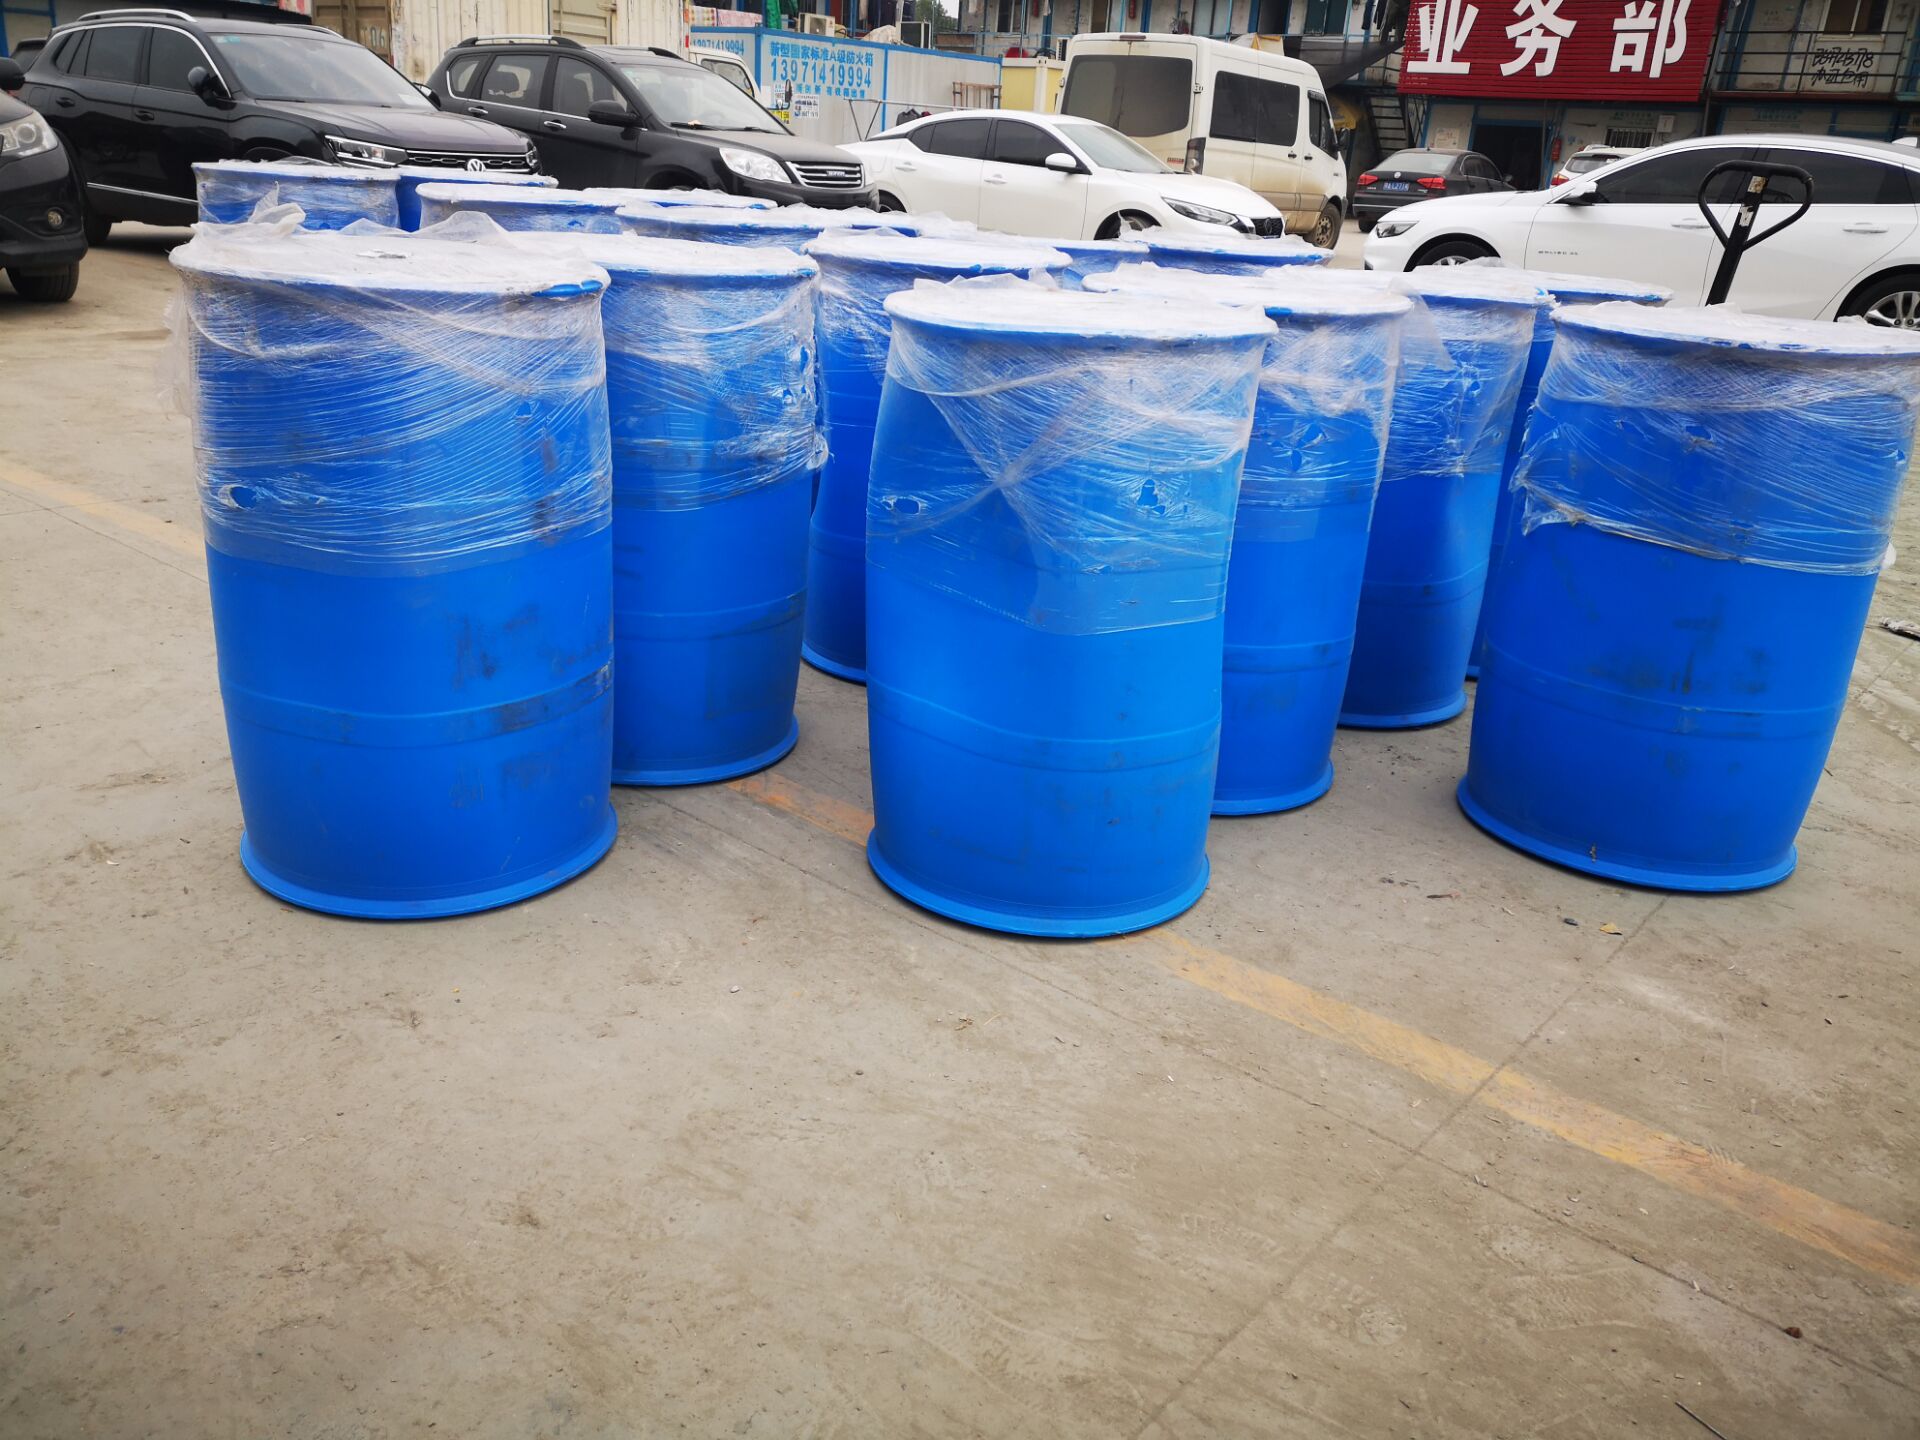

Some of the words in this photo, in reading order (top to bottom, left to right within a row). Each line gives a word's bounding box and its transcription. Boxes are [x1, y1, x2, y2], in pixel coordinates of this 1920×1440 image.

[1406, 0, 1691, 78] 业务部
[770, 41, 874, 67] 新型国家标准A级防火箱
[771, 59, 871, 88] 13971419994
